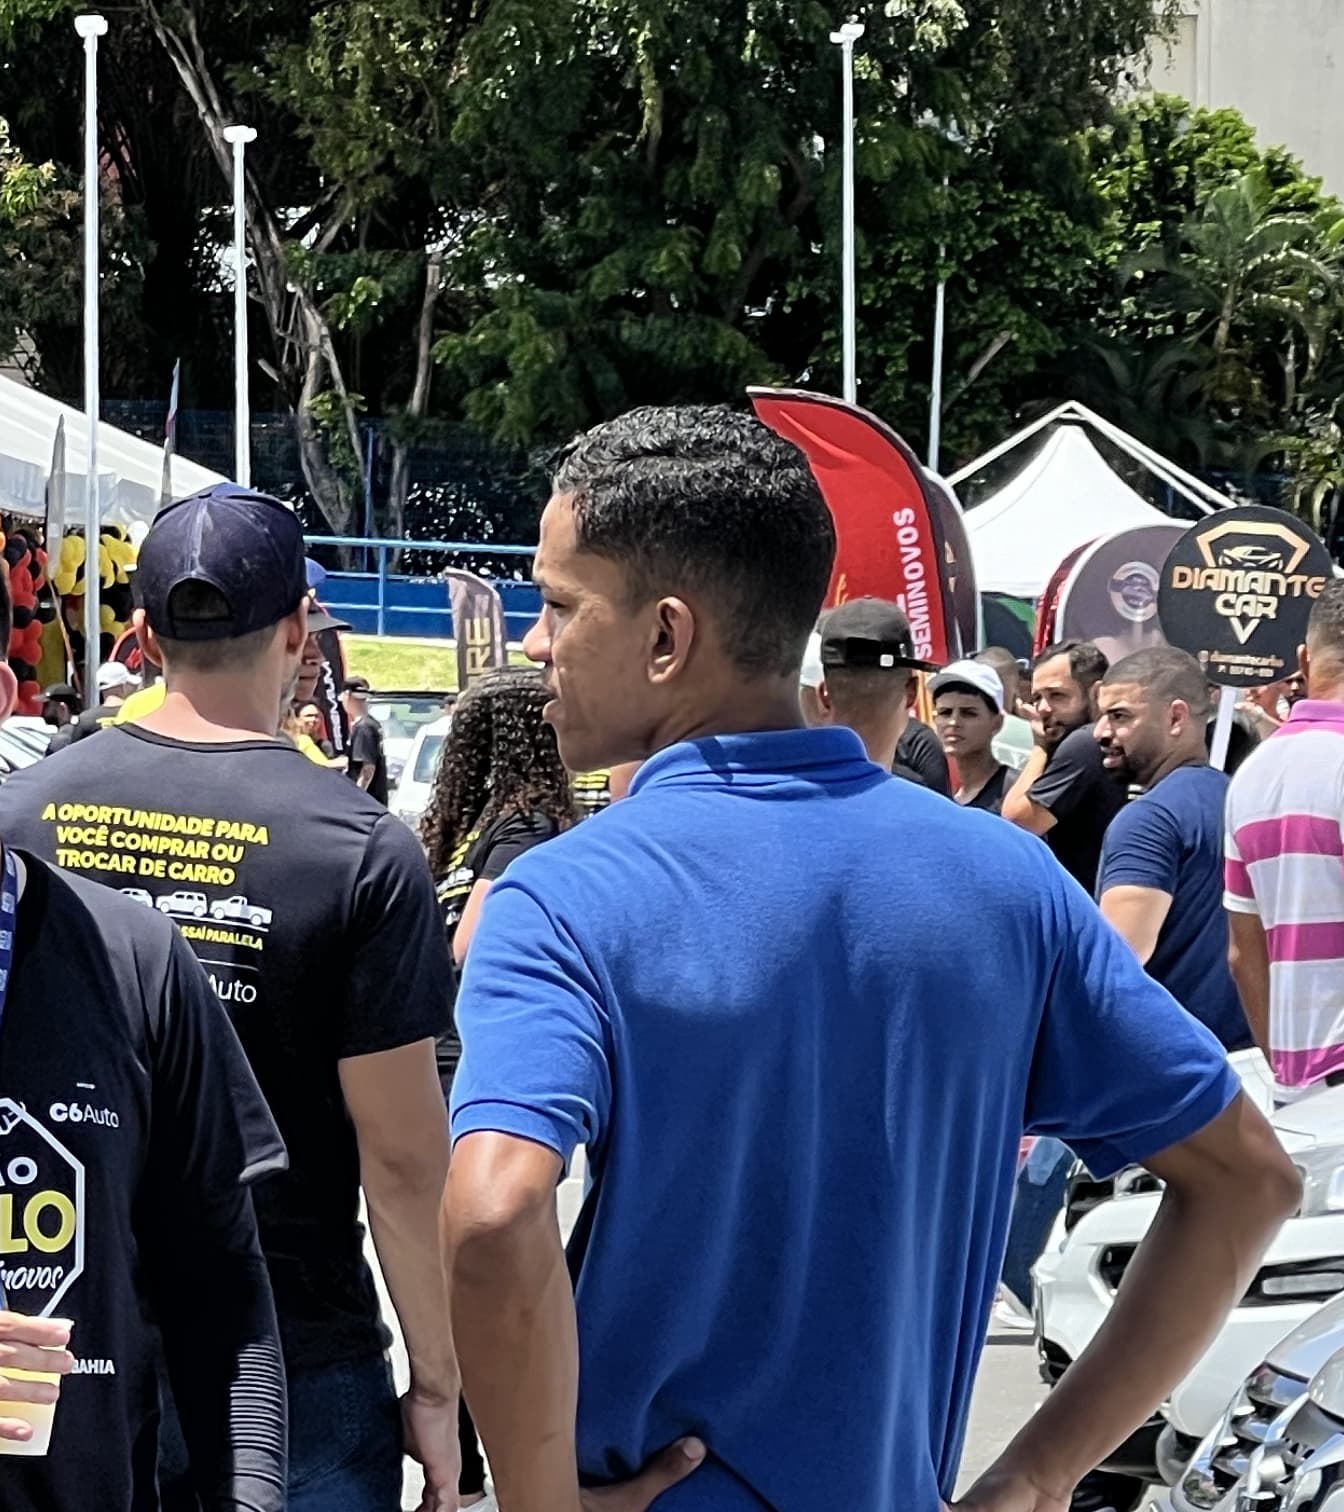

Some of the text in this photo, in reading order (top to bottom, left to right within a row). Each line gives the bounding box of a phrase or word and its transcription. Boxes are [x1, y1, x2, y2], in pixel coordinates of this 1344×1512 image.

[893, 508, 933, 660] SEMINOVOS
[1172, 565, 1327, 598] DIAMANTE
[1215, 593, 1279, 619] CAR
[42, 803, 270, 845] A OPORTUNIDADE PARA
[56, 825, 245, 864] VOCÊ COMPRAR OU
[56, 849, 236, 887] TROCAR DE CARRO
[179, 925, 263, 951] SSAÍ PARALELA
[49, 1102, 120, 1128] C6Auto
